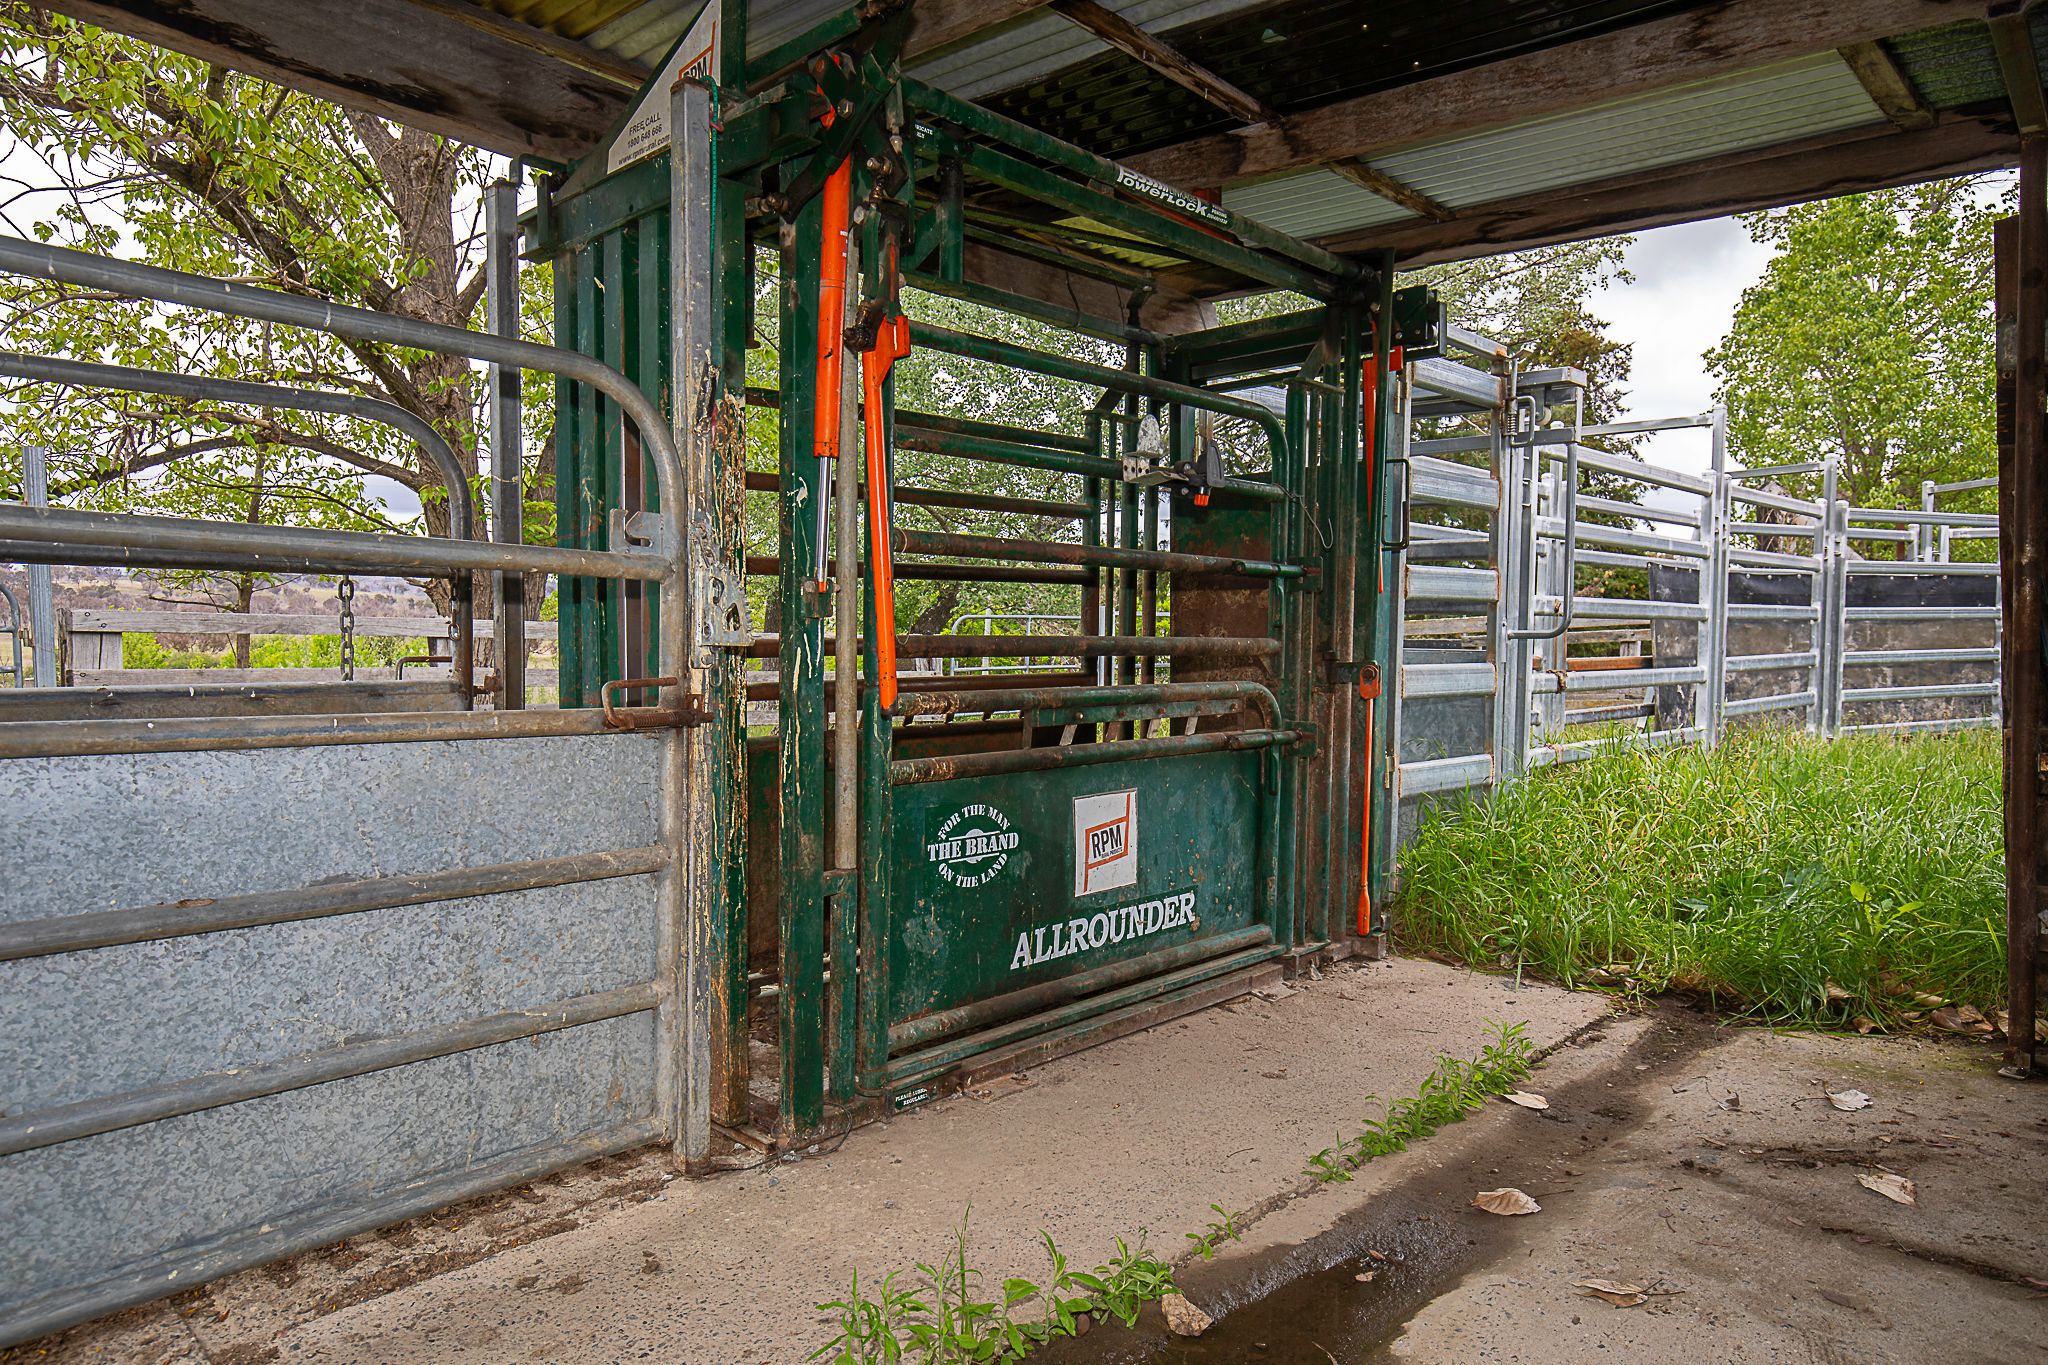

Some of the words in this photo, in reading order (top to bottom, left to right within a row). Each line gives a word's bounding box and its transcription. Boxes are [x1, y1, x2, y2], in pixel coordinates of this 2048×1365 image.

[629, 121, 645, 136] FREE
[645, 112, 661, 127] CALL
[937, 812, 961, 841] FOR
[961, 804, 986, 818] THE
[987, 806, 1011, 831] MAN
[927, 840, 962, 862] THE
[965, 832, 1019, 856] BRAND
[1091, 824, 1122, 859] RPM
[938, 863, 955, 882] ON
[955, 875, 979, 888] THE
[980, 853, 1008, 884] LAND
[1010, 892, 1196, 970] ALLROUNDER
